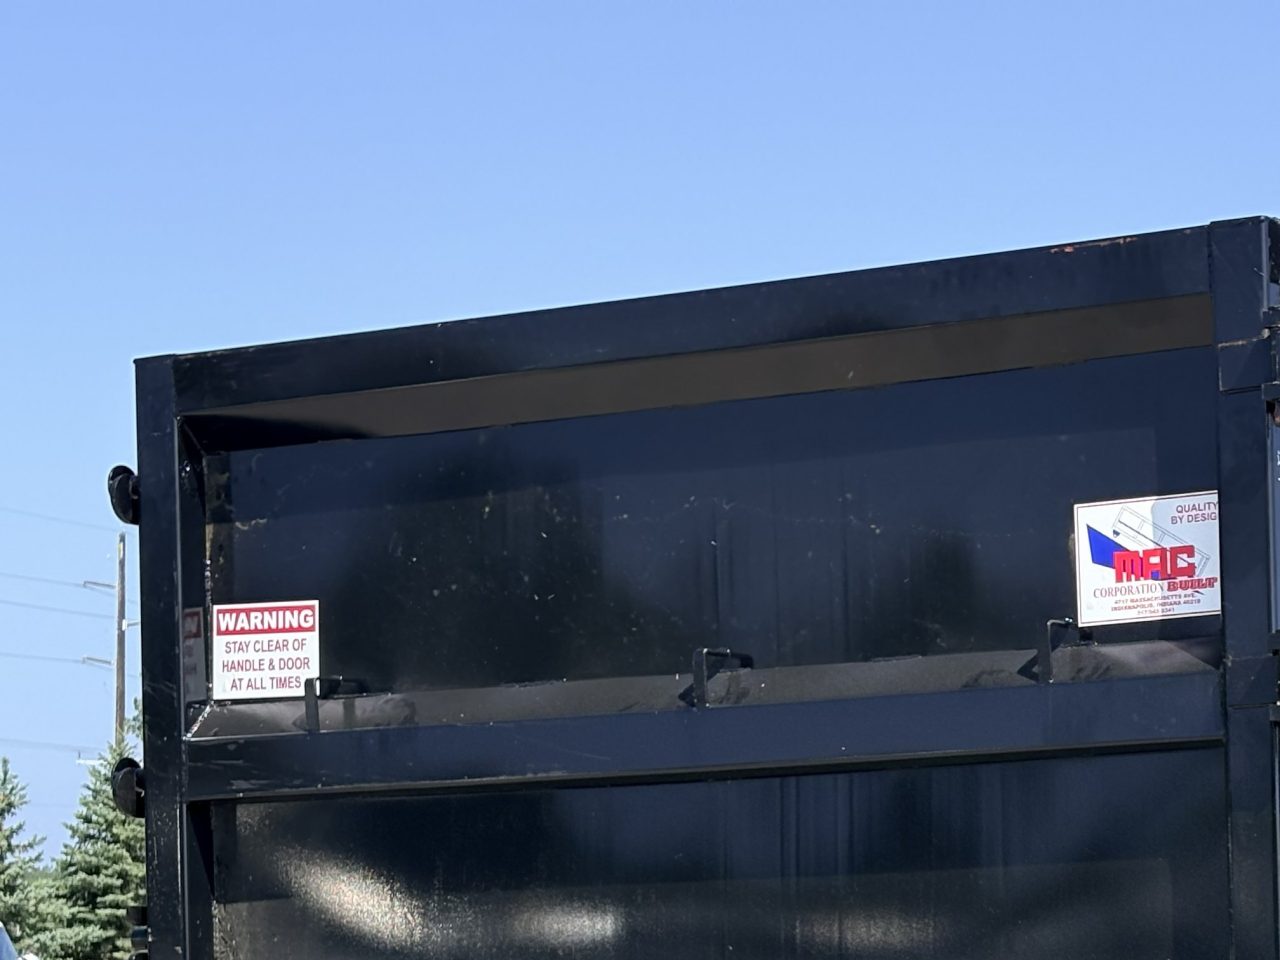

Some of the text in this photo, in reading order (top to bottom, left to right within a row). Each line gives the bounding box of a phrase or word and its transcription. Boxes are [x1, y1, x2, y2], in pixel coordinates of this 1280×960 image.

[1171, 515, 1184, 525] BY
[1113, 545, 1197, 583] MAC
[1093, 576, 1218, 599] CORPORATION BUILT
[217, 609, 314, 632] WARNING
[225, 638, 307, 654] STAY CLEAR OF
[222, 657, 310, 673] HANDLE & DOOR
[230, 676, 301, 691] AT ALL TIMES
